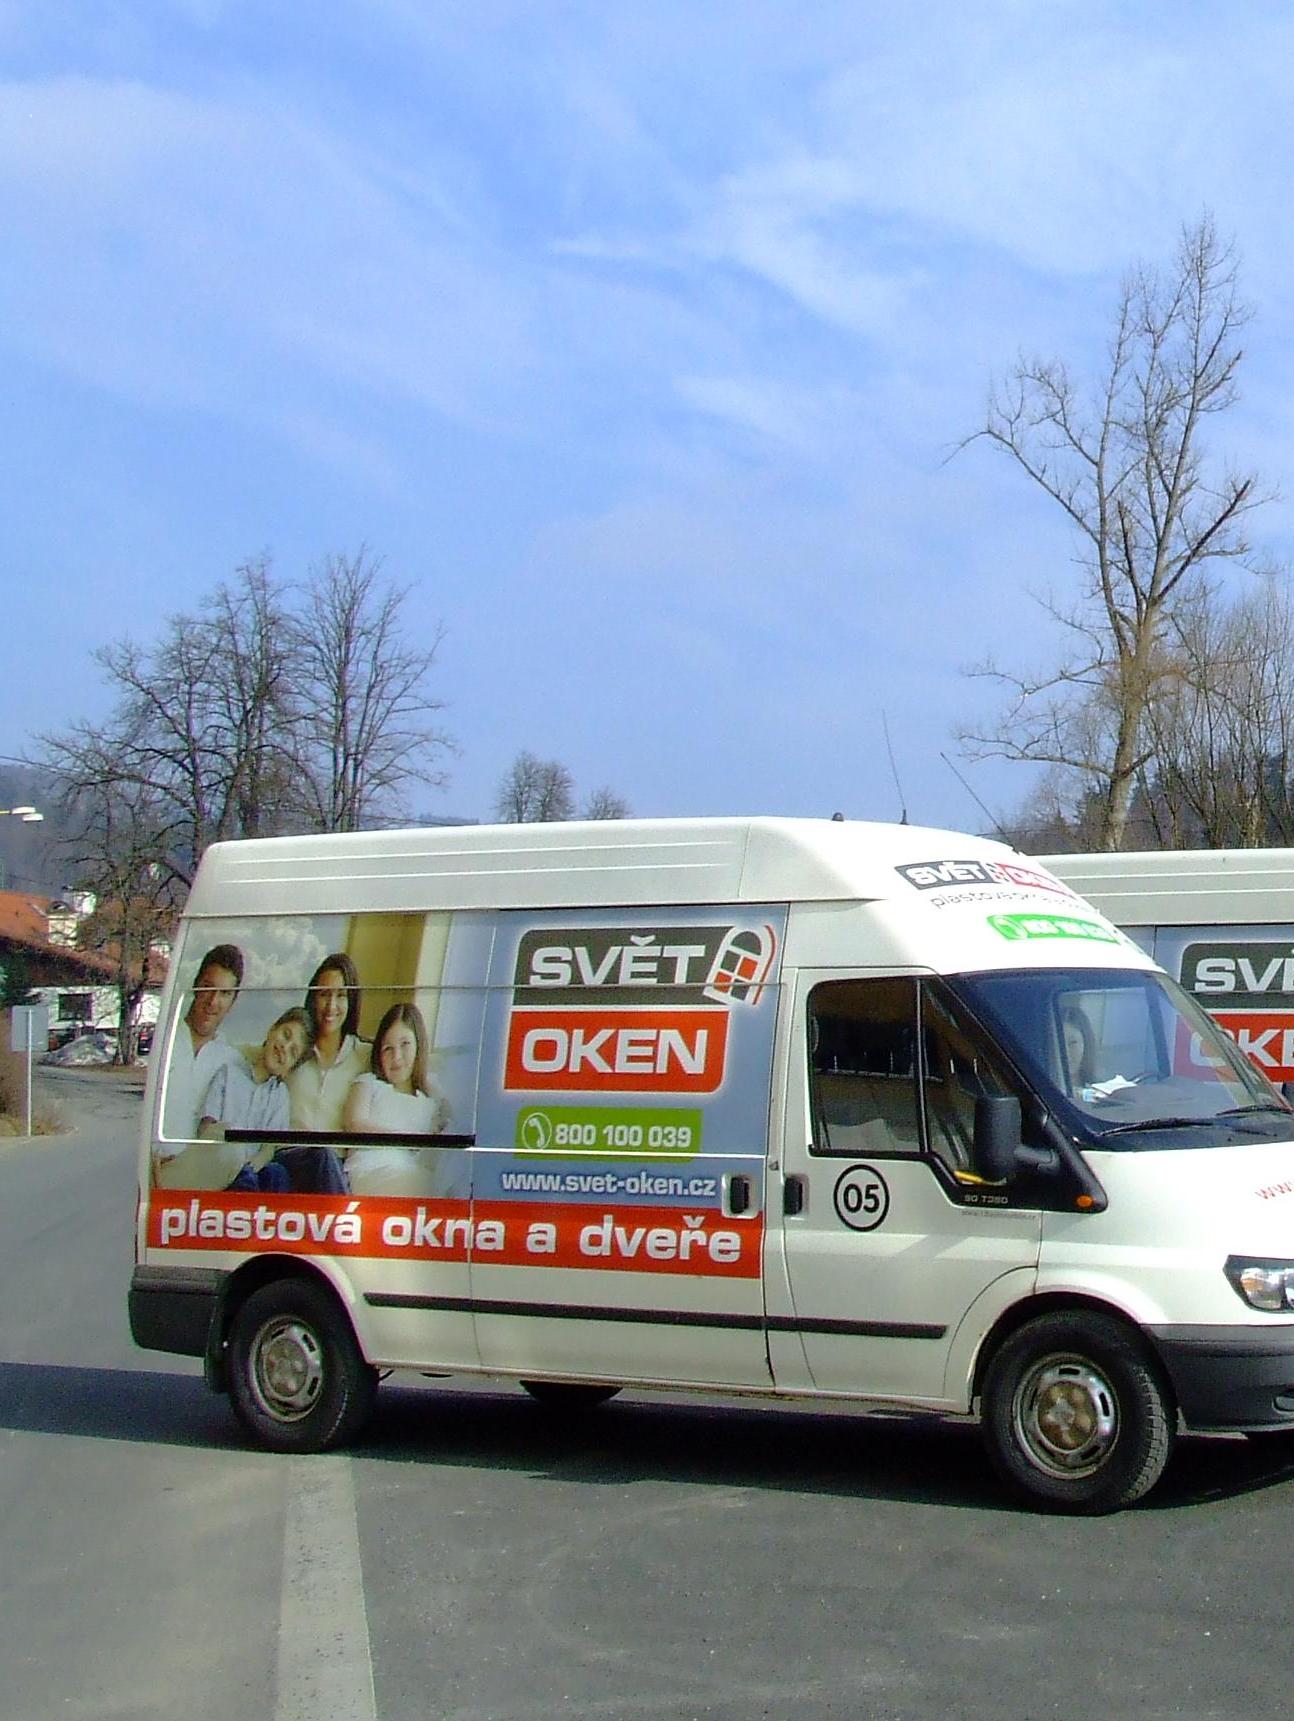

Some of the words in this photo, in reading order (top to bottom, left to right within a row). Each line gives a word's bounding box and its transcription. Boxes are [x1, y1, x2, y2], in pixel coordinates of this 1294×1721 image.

[528, 934, 706, 988] SVĚT
[521, 1027, 709, 1075] OKEN
[554, 1123, 596, 1146] 800
[602, 1124, 643, 1147] 100
[648, 1125, 692, 1149] 039
[501, 1170, 717, 1197] www.svet-oken.cz
[843, 1183, 880, 1214] 05
[160, 1199, 363, 1245] plastová
[382, 1206, 506, 1251] okna
[526, 1221, 557, 1254] a
[579, 1213, 742, 1264] dveře
